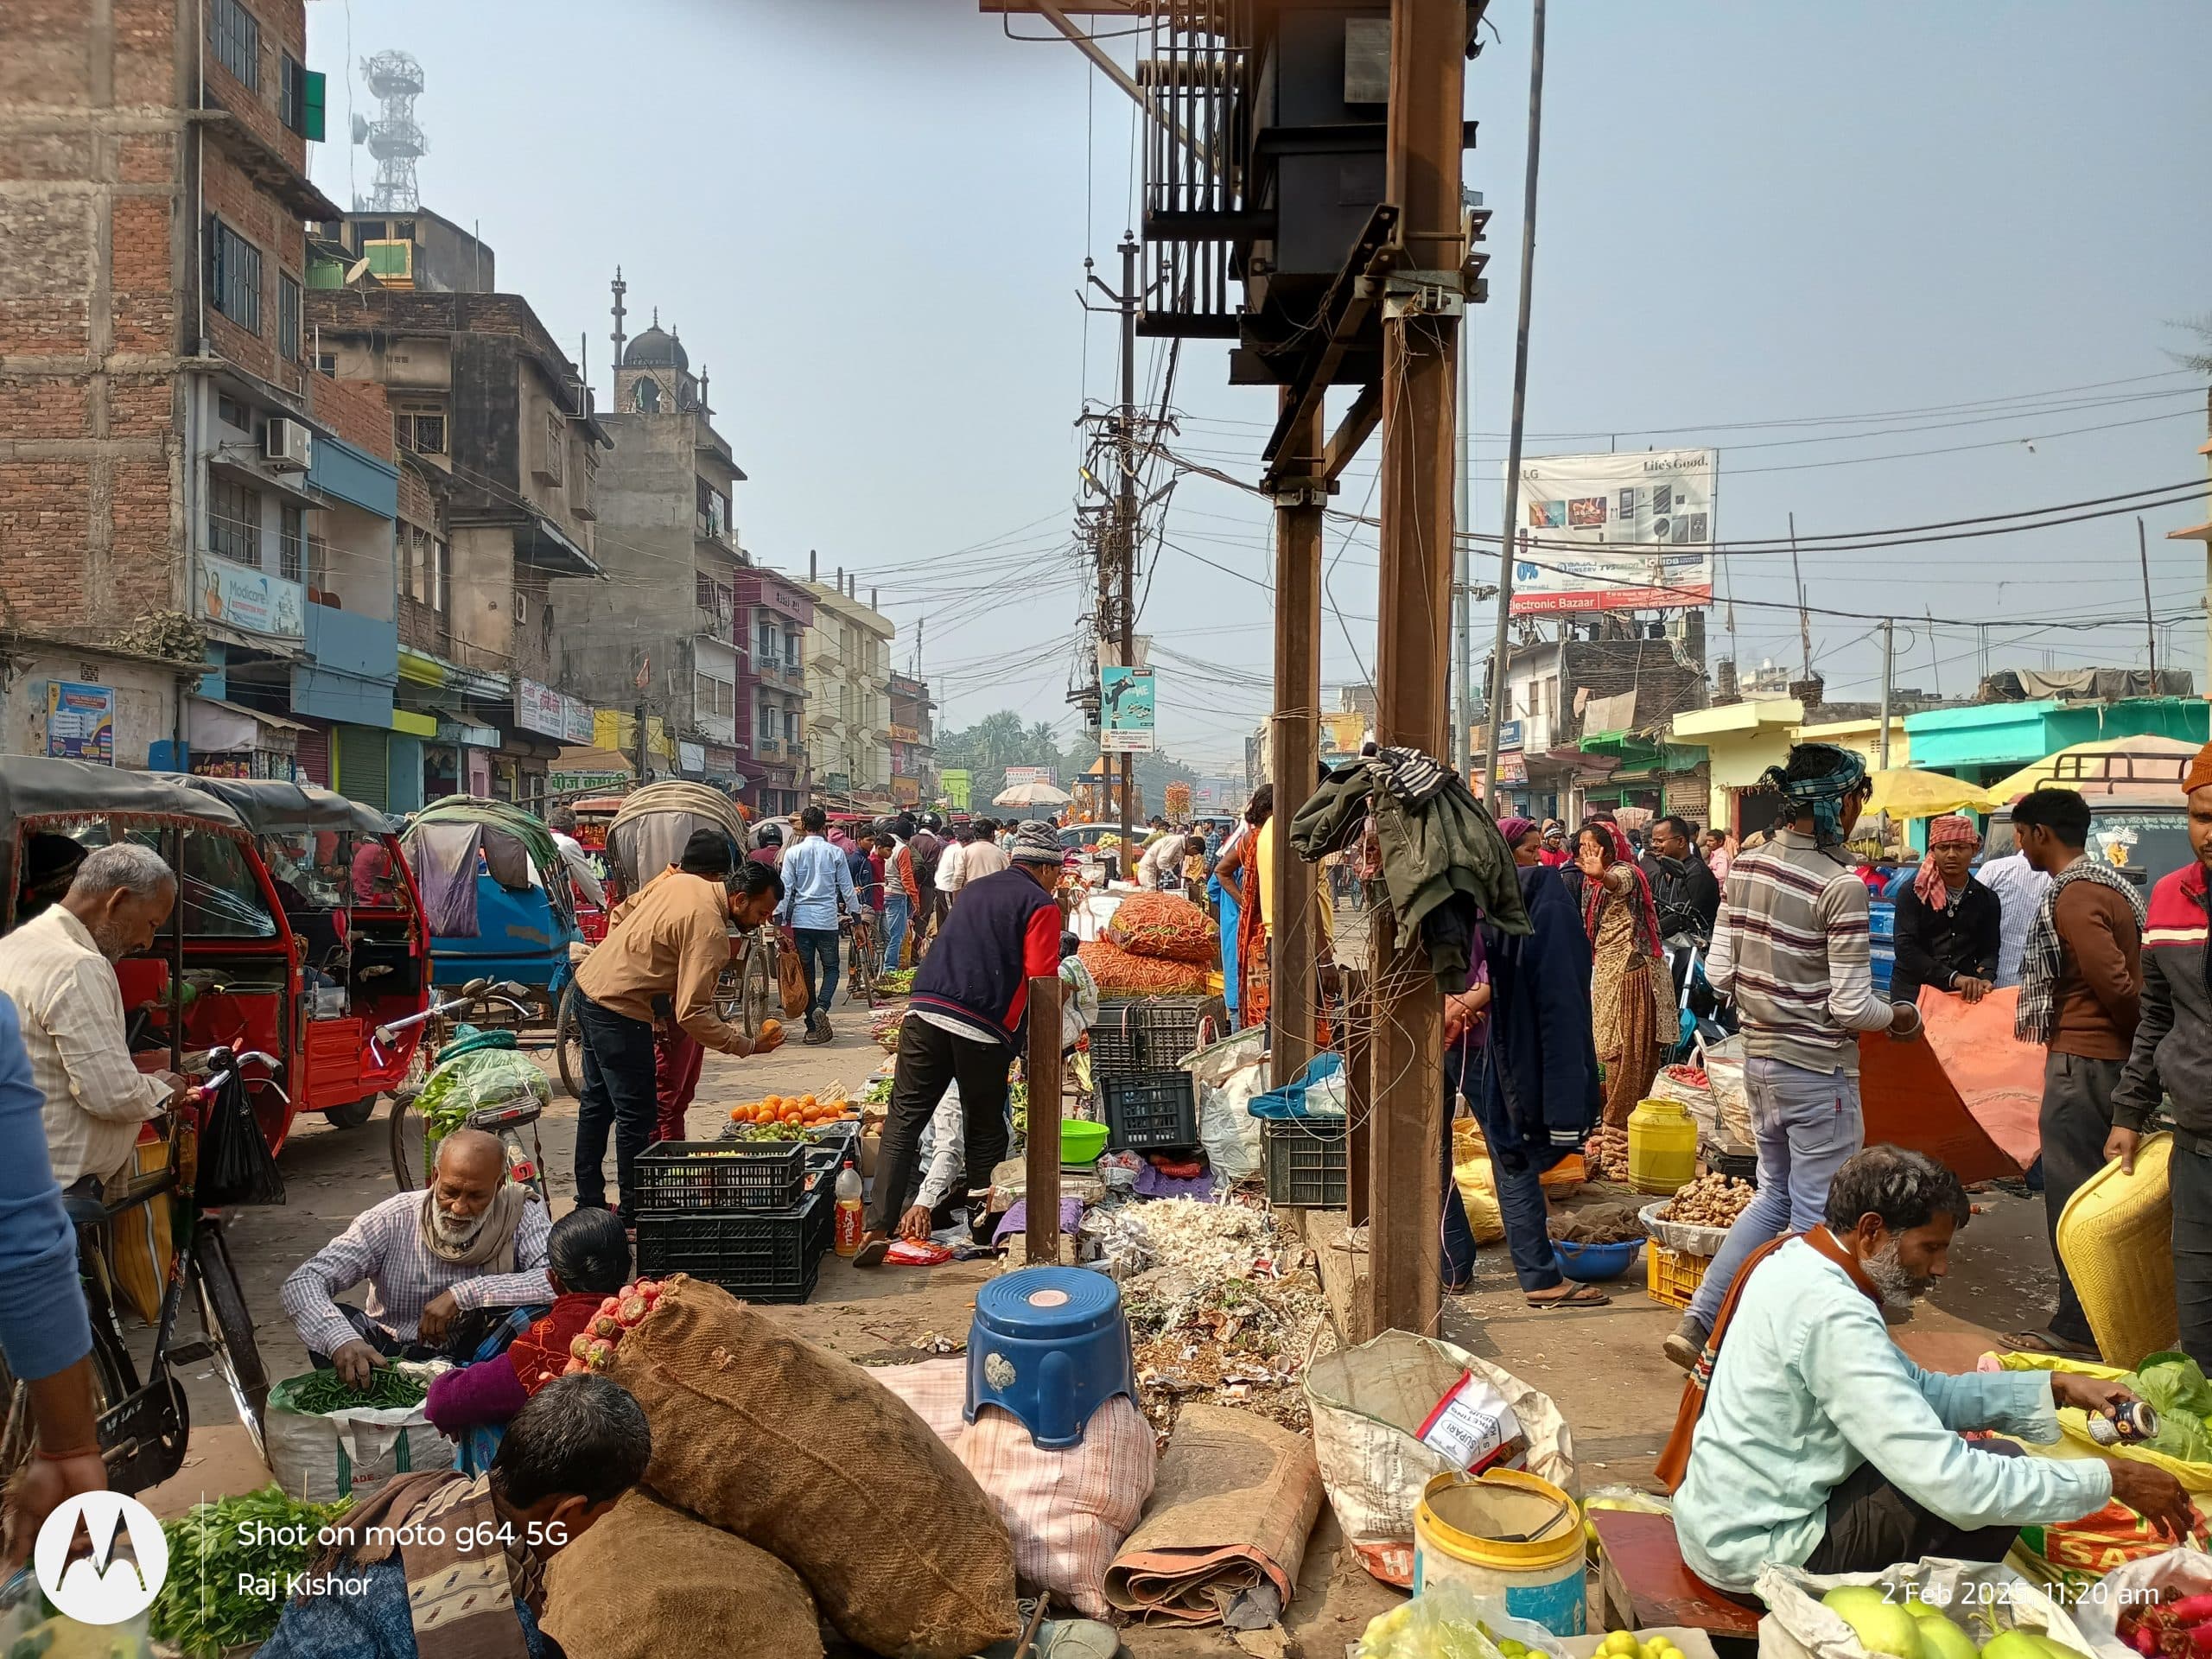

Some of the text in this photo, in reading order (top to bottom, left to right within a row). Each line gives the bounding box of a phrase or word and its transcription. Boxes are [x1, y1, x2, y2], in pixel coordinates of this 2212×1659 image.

[1643, 455, 1708, 471] Life's Good.
[1522, 469, 1539, 479] LG
[1516, 562, 1539, 582] 0%
[1559, 597, 1595, 608] Bazaar
[551, 772, 580, 789] बीज
[844, 1211, 854, 1246] maaza
[1446, 1423, 1478, 1450] SUPARI
